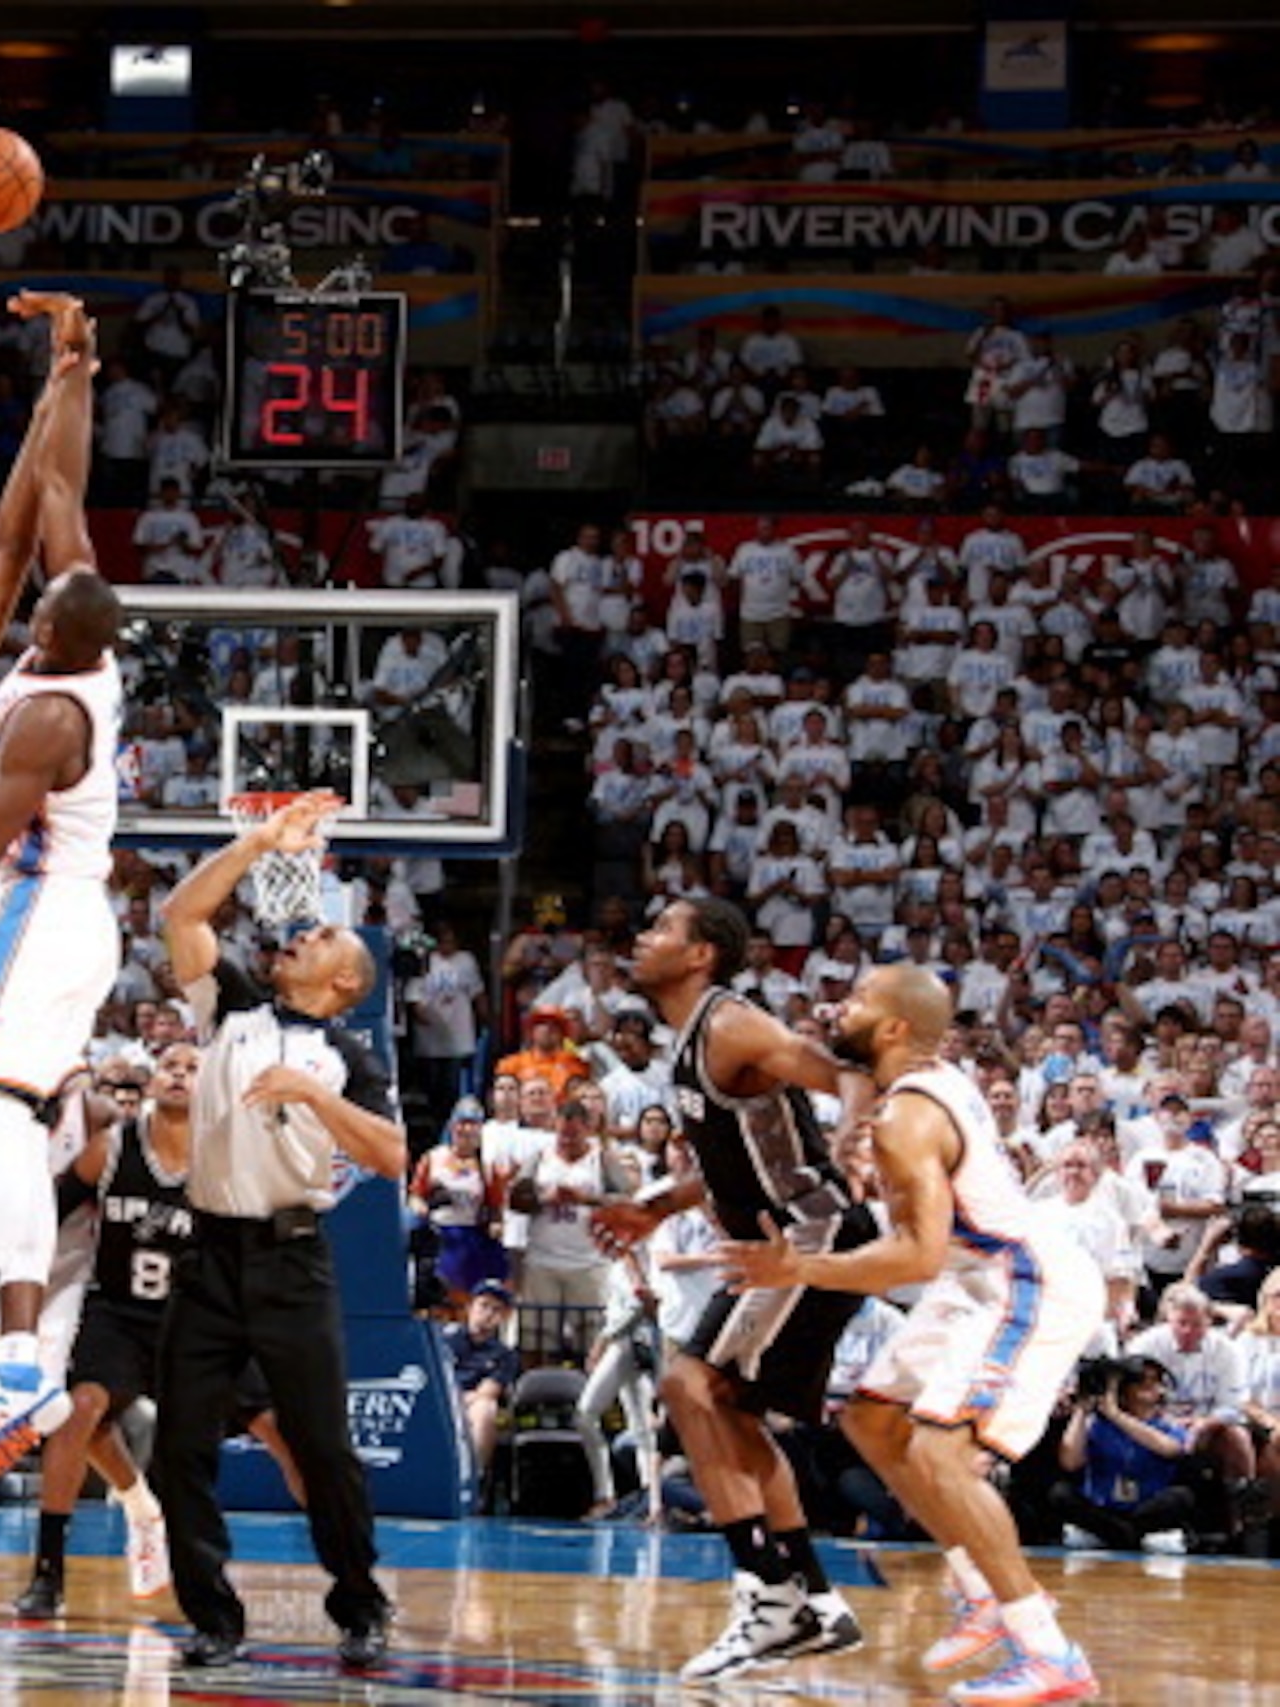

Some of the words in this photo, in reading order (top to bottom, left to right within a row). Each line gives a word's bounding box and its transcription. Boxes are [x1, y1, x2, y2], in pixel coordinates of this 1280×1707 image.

[699, 203, 1052, 248] RIVERWIND
[282, 312, 382, 357] 5:00
[261, 363, 369, 446] 24
[631, 518, 705, 557] 10
[130, 1249, 171, 1300] 8
